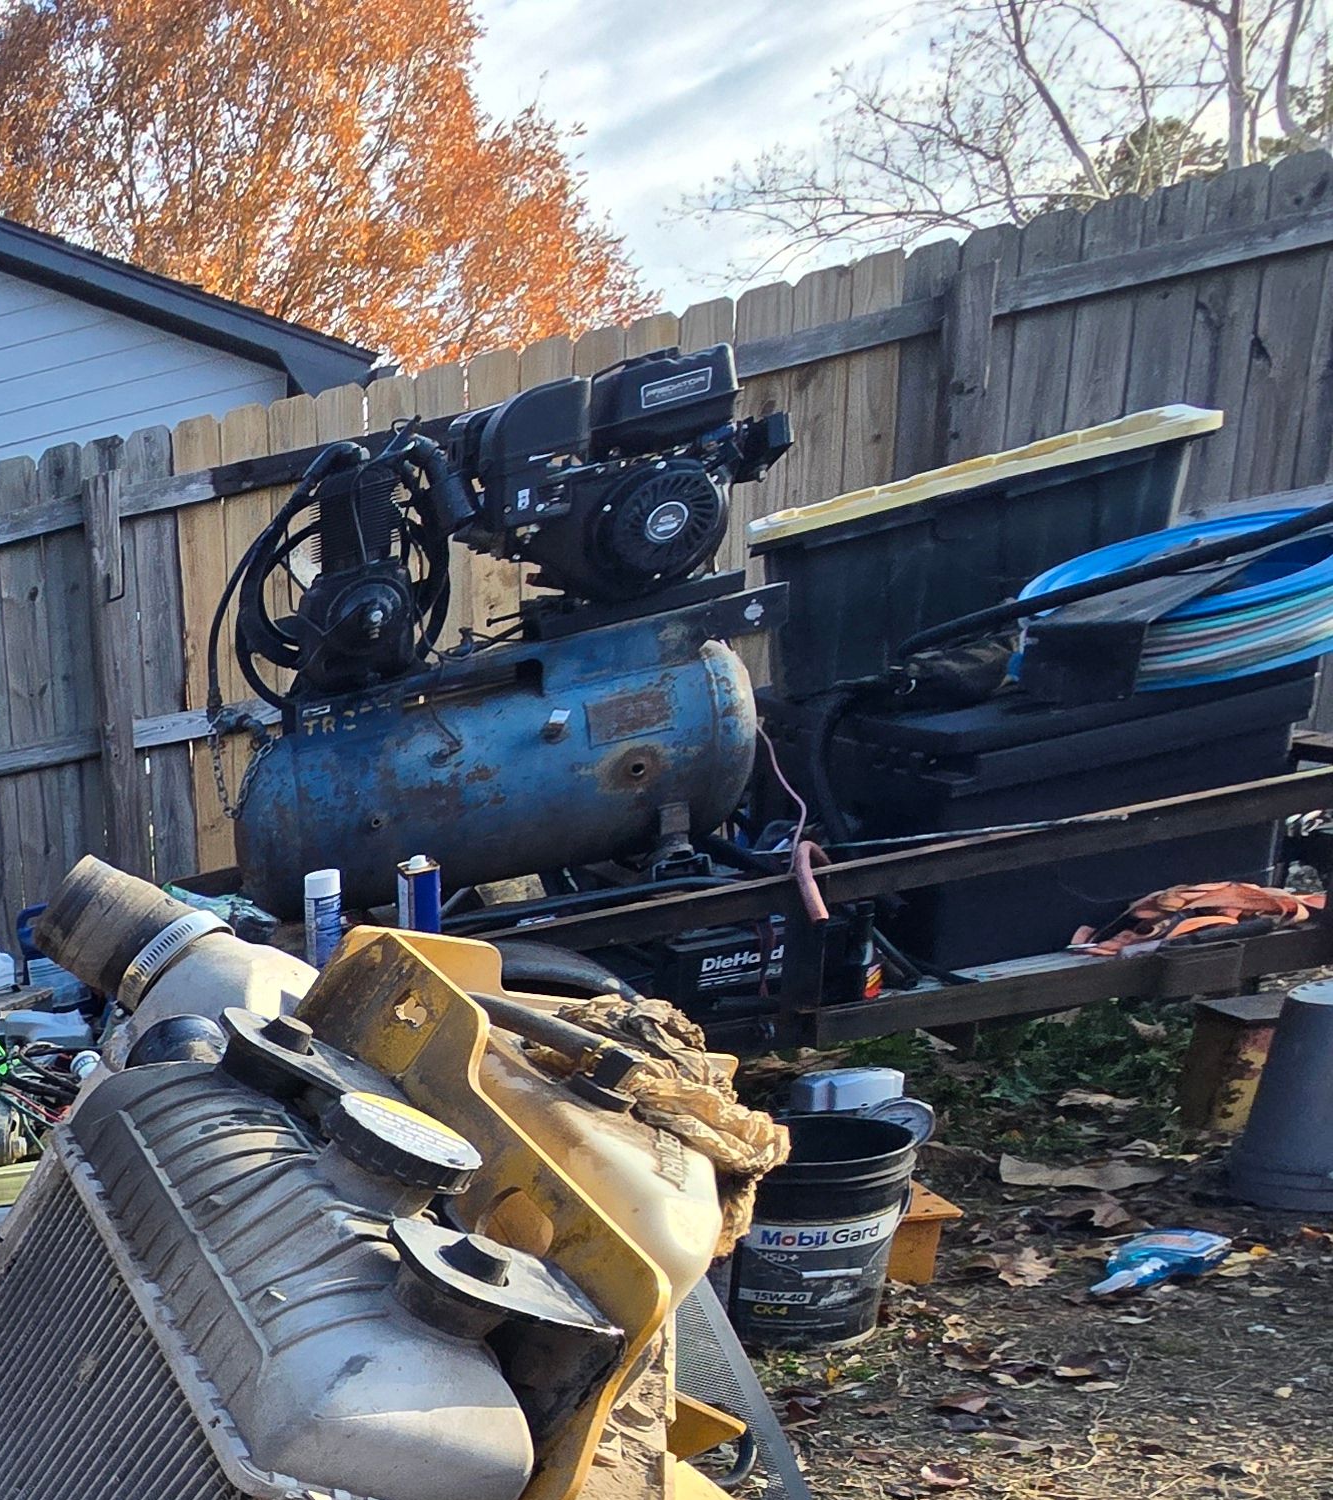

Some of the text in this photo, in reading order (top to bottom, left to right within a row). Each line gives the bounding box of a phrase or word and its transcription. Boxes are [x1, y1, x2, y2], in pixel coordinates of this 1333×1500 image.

[701, 945, 785, 972] DieHad
[760, 1222, 880, 1247] Mobil Gard
[753, 1291, 807, 1303] 15W-40
[753, 1304, 789, 1316] CK-4
